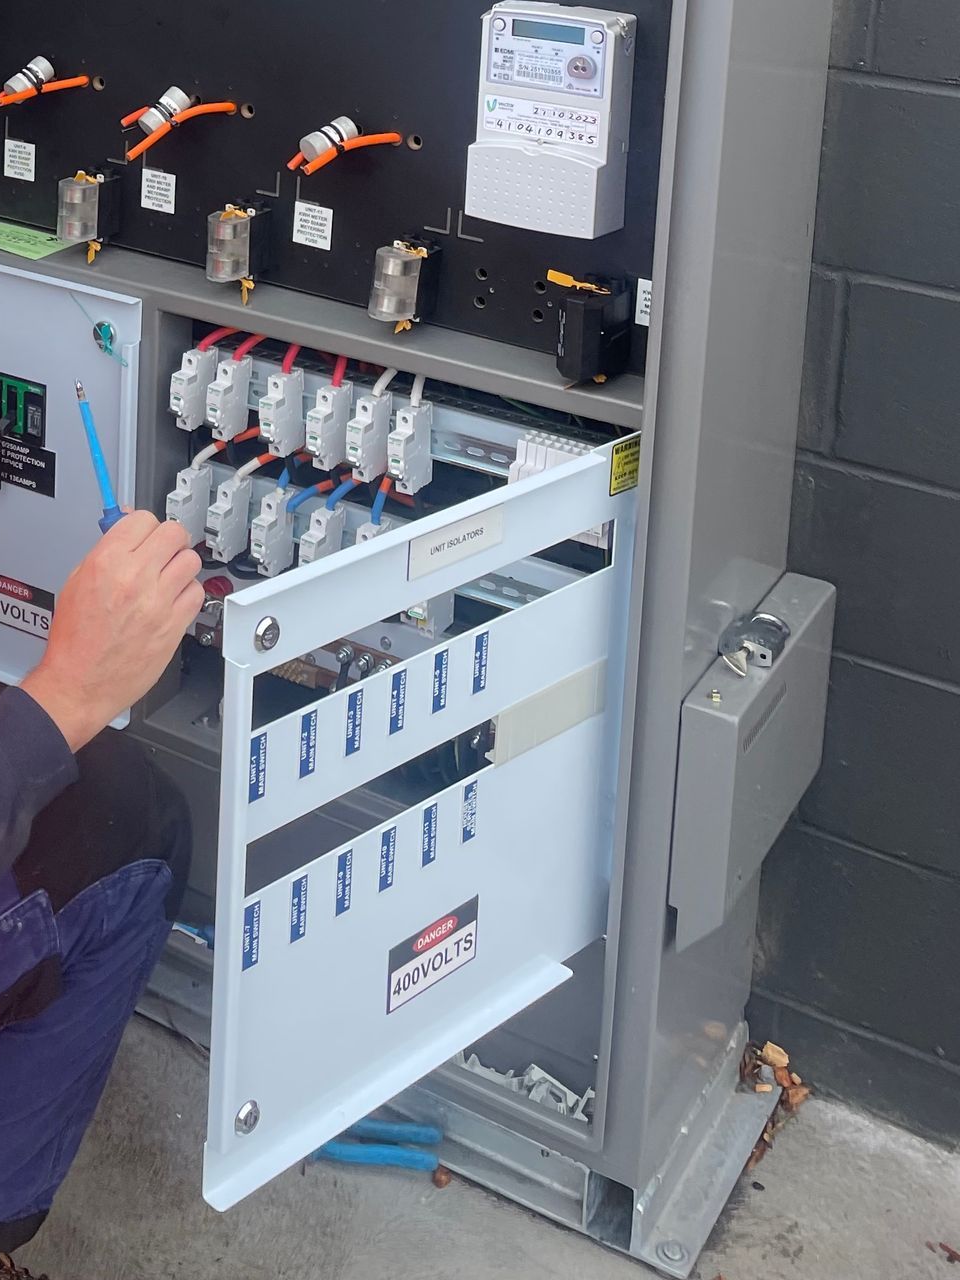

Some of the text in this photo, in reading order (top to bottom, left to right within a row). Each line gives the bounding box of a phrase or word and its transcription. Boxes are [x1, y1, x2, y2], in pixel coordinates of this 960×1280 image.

[297, 228, 327, 239] PROTECTION
[300, 223, 324, 232] METERING
[7, 450, 45, 469] PROTECTION
[430, 528, 484, 556] UNIT ISOLATORS
[417, 919, 453, 949] DANGER
[393, 932, 473, 996] 400VOLTS
